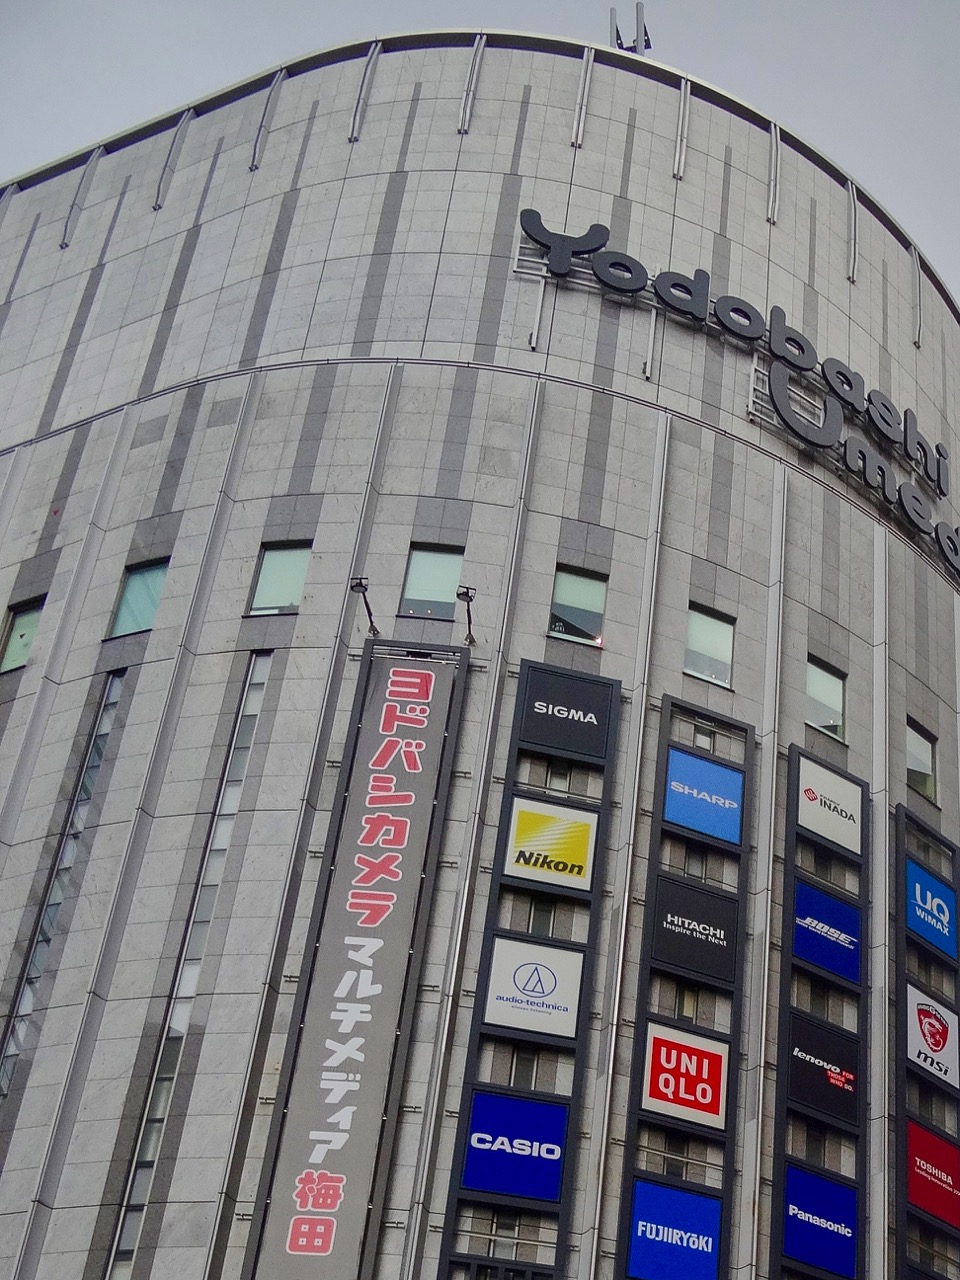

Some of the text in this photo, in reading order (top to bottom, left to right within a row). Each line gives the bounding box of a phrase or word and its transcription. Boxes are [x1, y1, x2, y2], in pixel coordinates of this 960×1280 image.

[520, 208, 949, 499] Yodobashi
[533, 701, 598, 725] SIGMA
[345, 667, 436, 928] ヨドバシカメラ
[670, 780, 739, 810] SHARP
[819, 797, 857, 825] INADA
[514, 850, 584, 876] Nikon
[915, 882, 950, 926] UQ
[663, 921, 728, 947] Inspire the Next
[667, 913, 726, 940] HITACHI
[796, 916, 858, 944] BOSE
[495, 994, 569, 1013] audio-technica
[660, 1047, 709, 1080] UNI
[793, 1047, 855, 1081] lenovo FOR
[827, 1071, 846, 1083] THOSE
[916, 1049, 951, 1077] msi
[658, 1073, 713, 1104] QLO
[470, 1132, 561, 1160] CASIO
[914, 1156, 953, 1186] TOSHIBA
[789, 1204, 852, 1238] Panasonic
